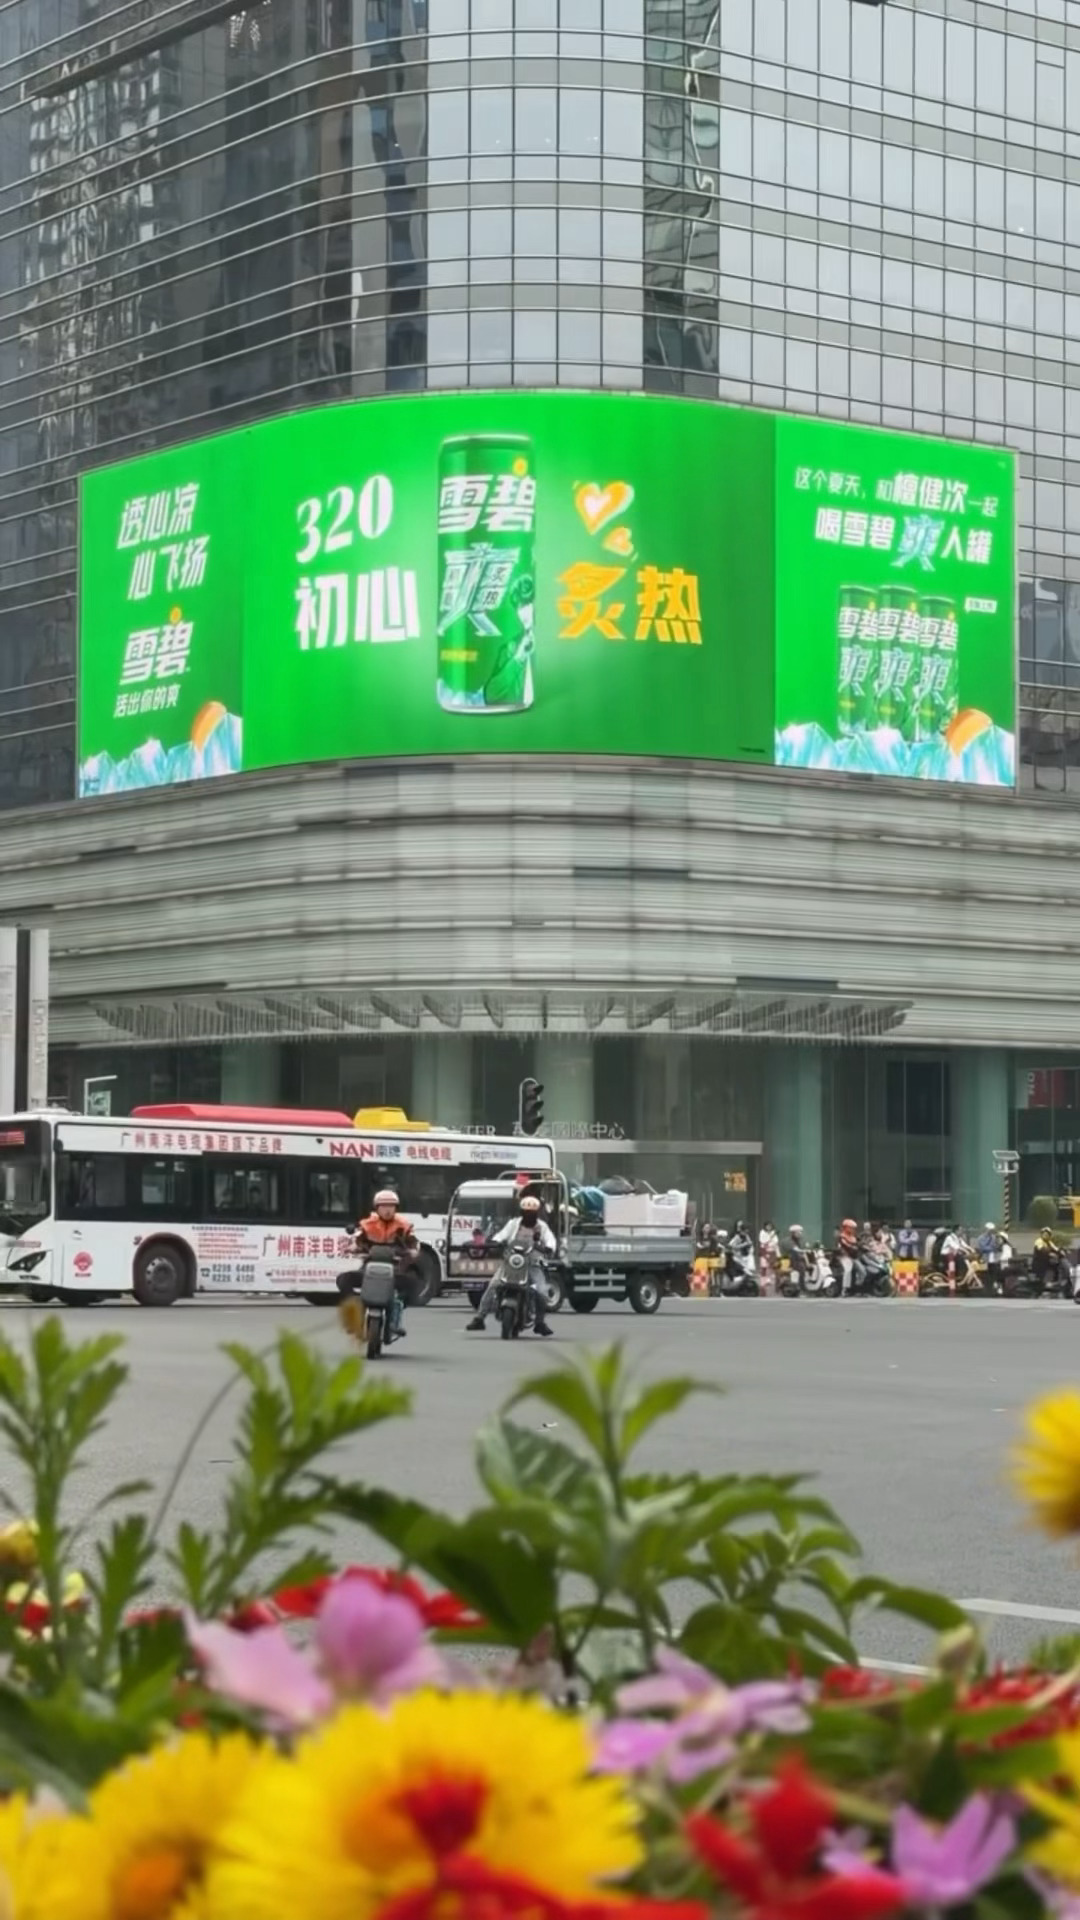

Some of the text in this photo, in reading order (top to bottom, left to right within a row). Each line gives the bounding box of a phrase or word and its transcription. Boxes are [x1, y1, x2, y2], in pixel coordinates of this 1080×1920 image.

[116, 482, 199, 549] 透心凉
[295, 475, 394, 563] 320
[438, 473, 537, 533] 雪碧
[127, 535, 210, 600] 心飞扬
[294, 566, 420, 650] 初心
[555, 561, 703, 645] 炙热
[838, 606, 878, 642] 雪碧
[877, 607, 920, 644] 雪碧
[919, 617, 959, 651] 雪碧
[119, 621, 194, 686] 雪碧
[114, 683, 180, 718] 活出你的爽
[330, 1142, 374, 1158] NAN
